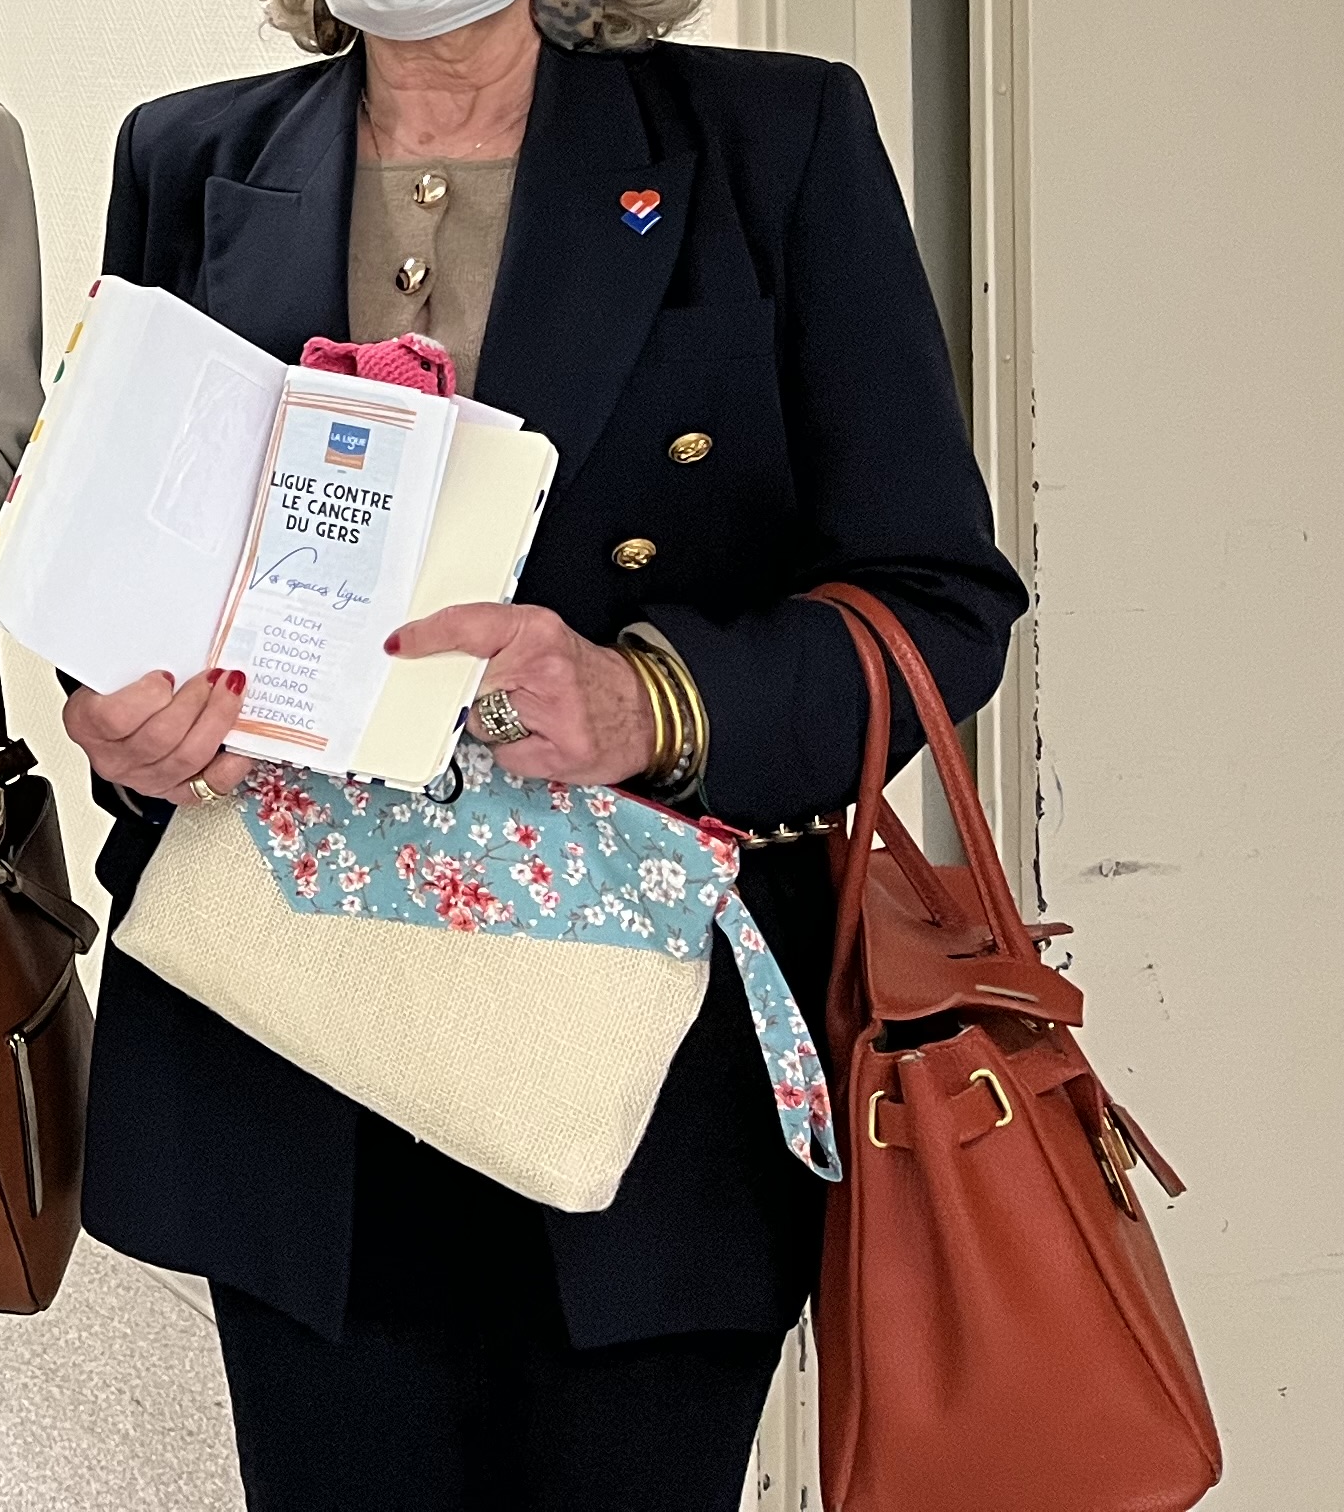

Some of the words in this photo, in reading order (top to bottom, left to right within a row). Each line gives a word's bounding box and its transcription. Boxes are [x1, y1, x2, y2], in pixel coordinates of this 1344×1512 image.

[270, 470, 317, 495] LIGUE
[323, 482, 394, 511] CONTRE
[281, 493, 302, 511] LE
[307, 499, 372, 527] CANCER
[285, 513, 310, 533] DU
[315, 521, 361, 544] GERS
[331, 579, 372, 610] ligue
[283, 614, 323, 632] AUCH
[263, 624, 327, 650] COLOGNE
[262, 641, 322, 664] CONDOM
[252, 655, 319, 680] LECTOURE
[253, 673, 309, 694] NOGARO
[244, 687, 315, 713] UJAUDRAN
[250, 704, 316, 730] FEZENSAC
